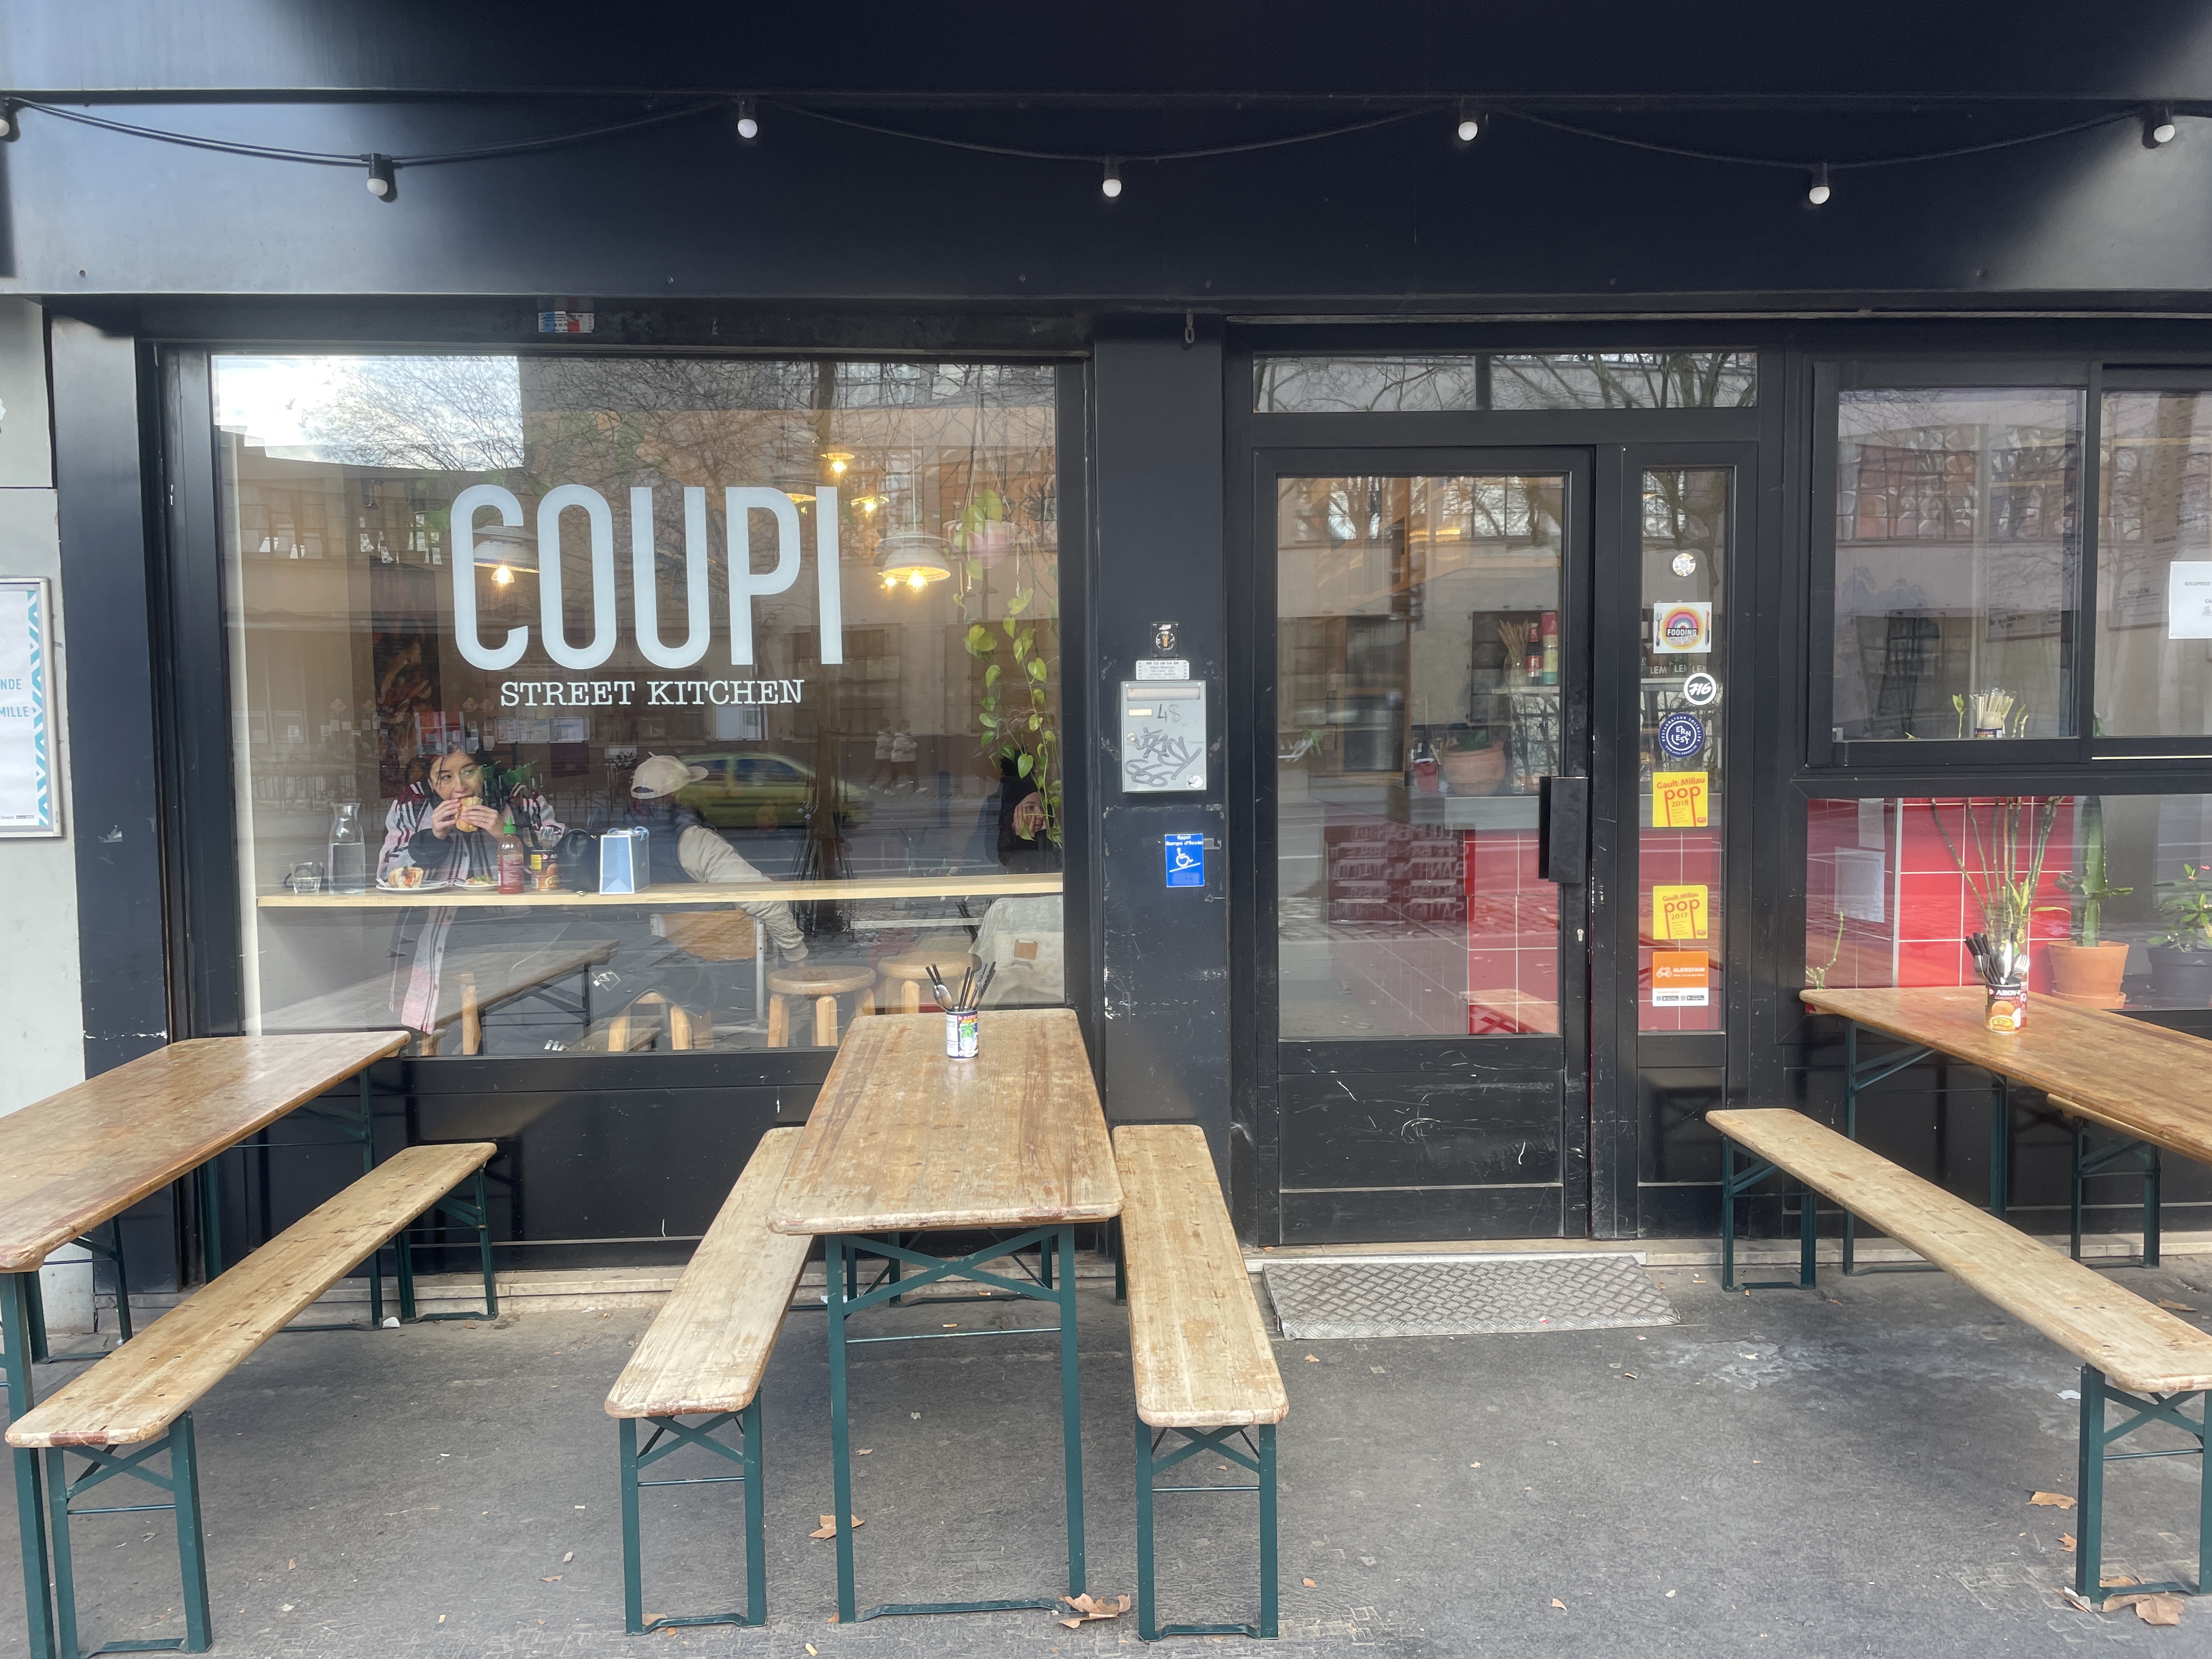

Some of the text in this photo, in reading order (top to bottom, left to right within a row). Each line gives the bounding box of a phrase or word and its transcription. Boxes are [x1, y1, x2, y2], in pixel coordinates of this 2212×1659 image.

[450, 484, 843, 671] COUPI
[500, 679, 803, 707] STREET KITCHEN
[1661, 716, 1702, 742] RESTAURATEUR SOLIDAIRE
[1664, 786, 1701, 827] pop
[1671, 799, 1689, 808] 2018
[1664, 899, 1700, 939] pop
